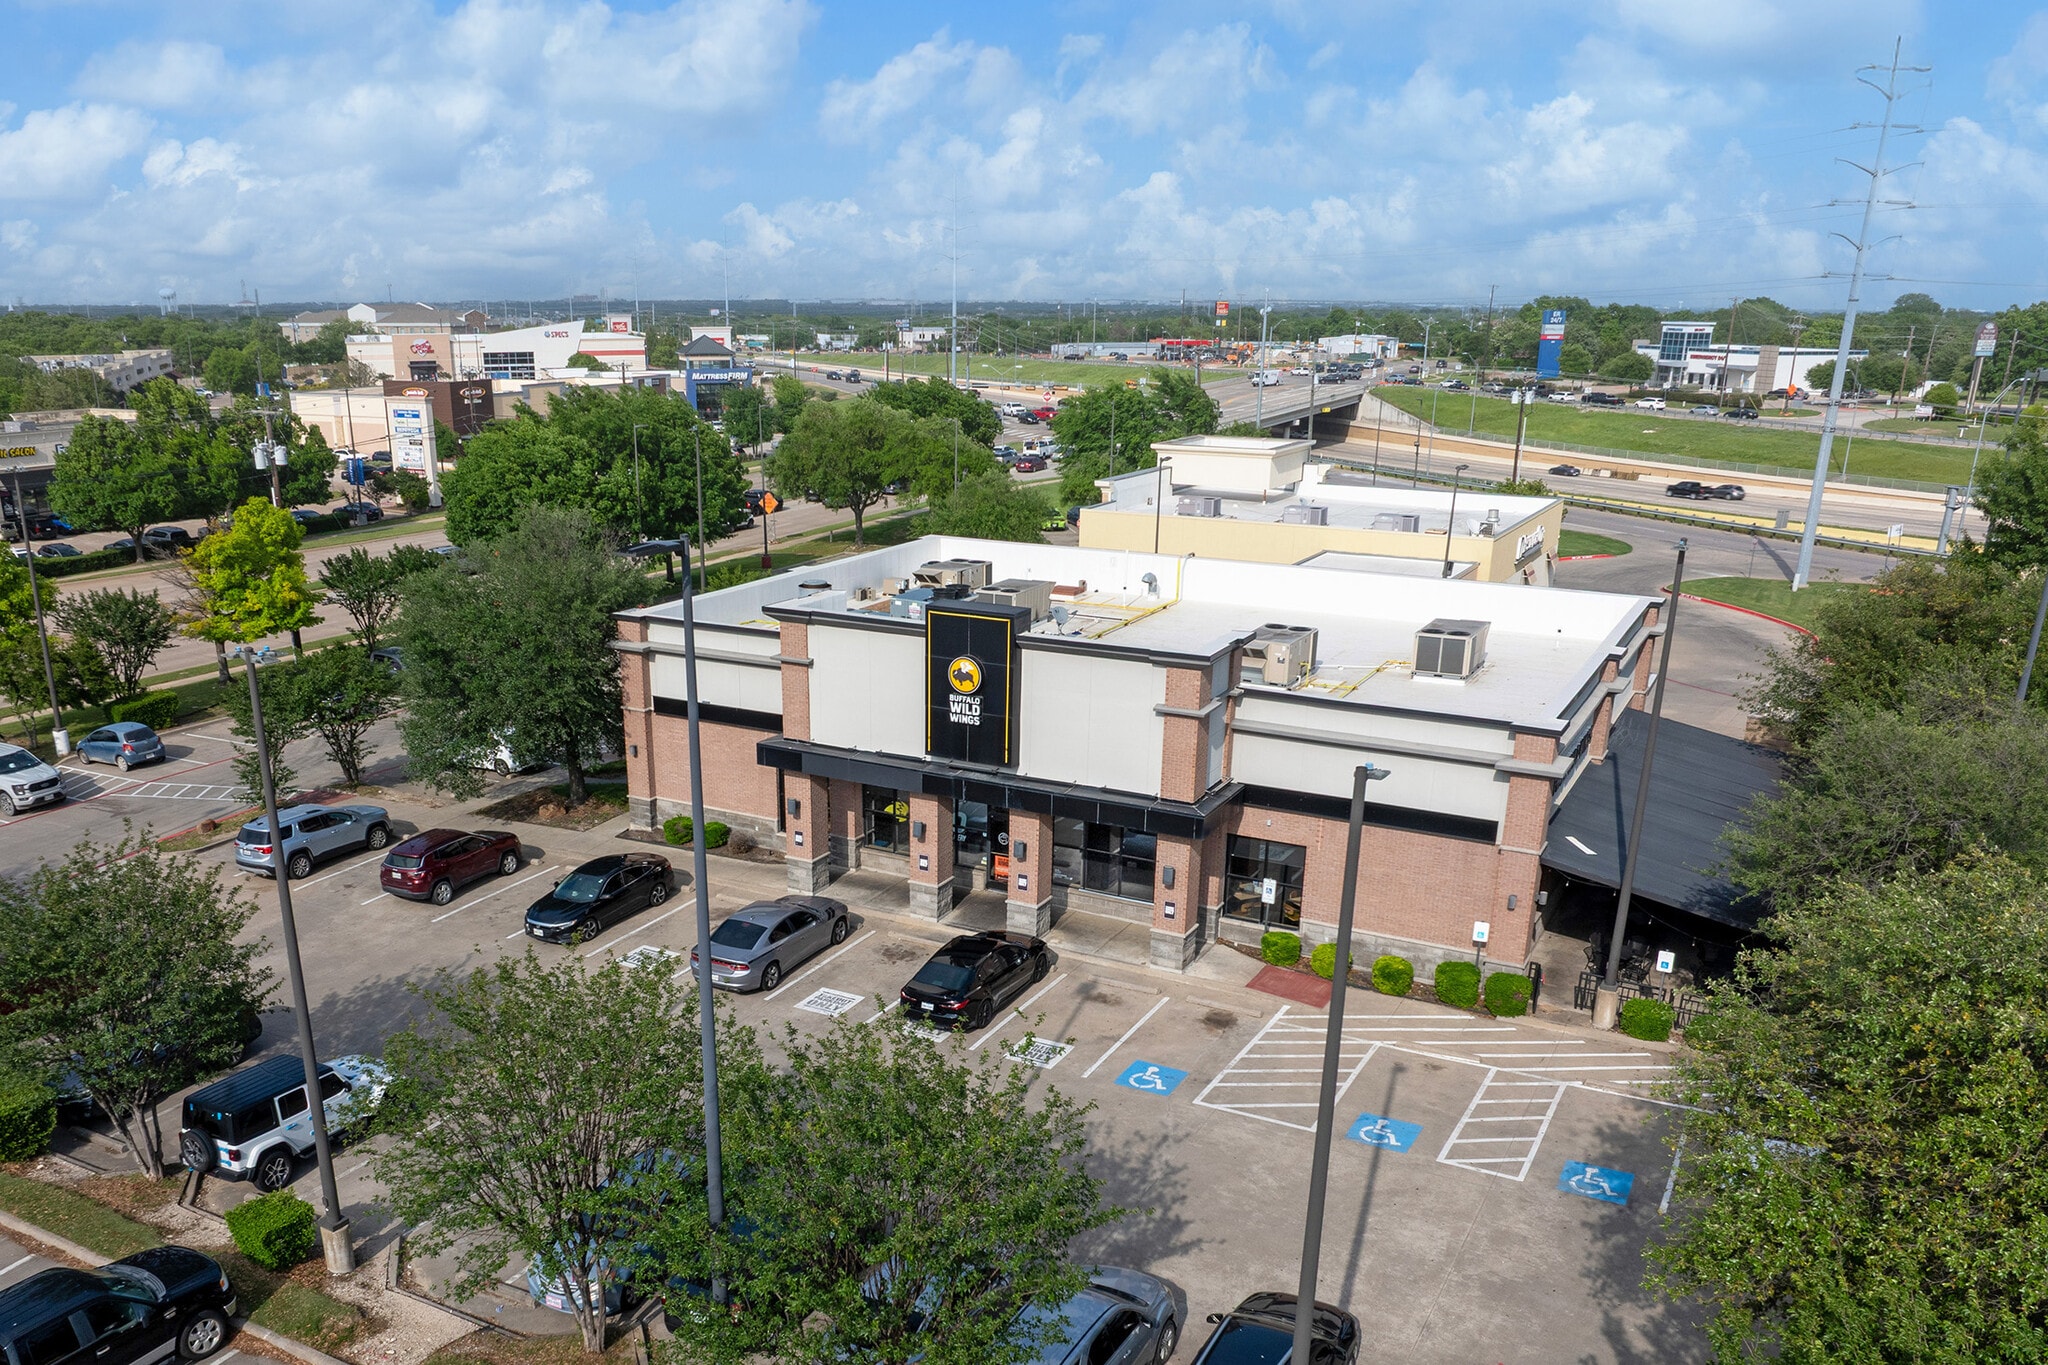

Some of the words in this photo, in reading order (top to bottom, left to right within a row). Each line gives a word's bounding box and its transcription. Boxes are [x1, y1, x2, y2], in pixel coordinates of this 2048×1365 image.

[9, 446, 36, 458] SALON
[949, 694, 980, 705] BUFFALO
[950, 702, 980, 716] WILD
[950, 713, 981, 726] WINGS
